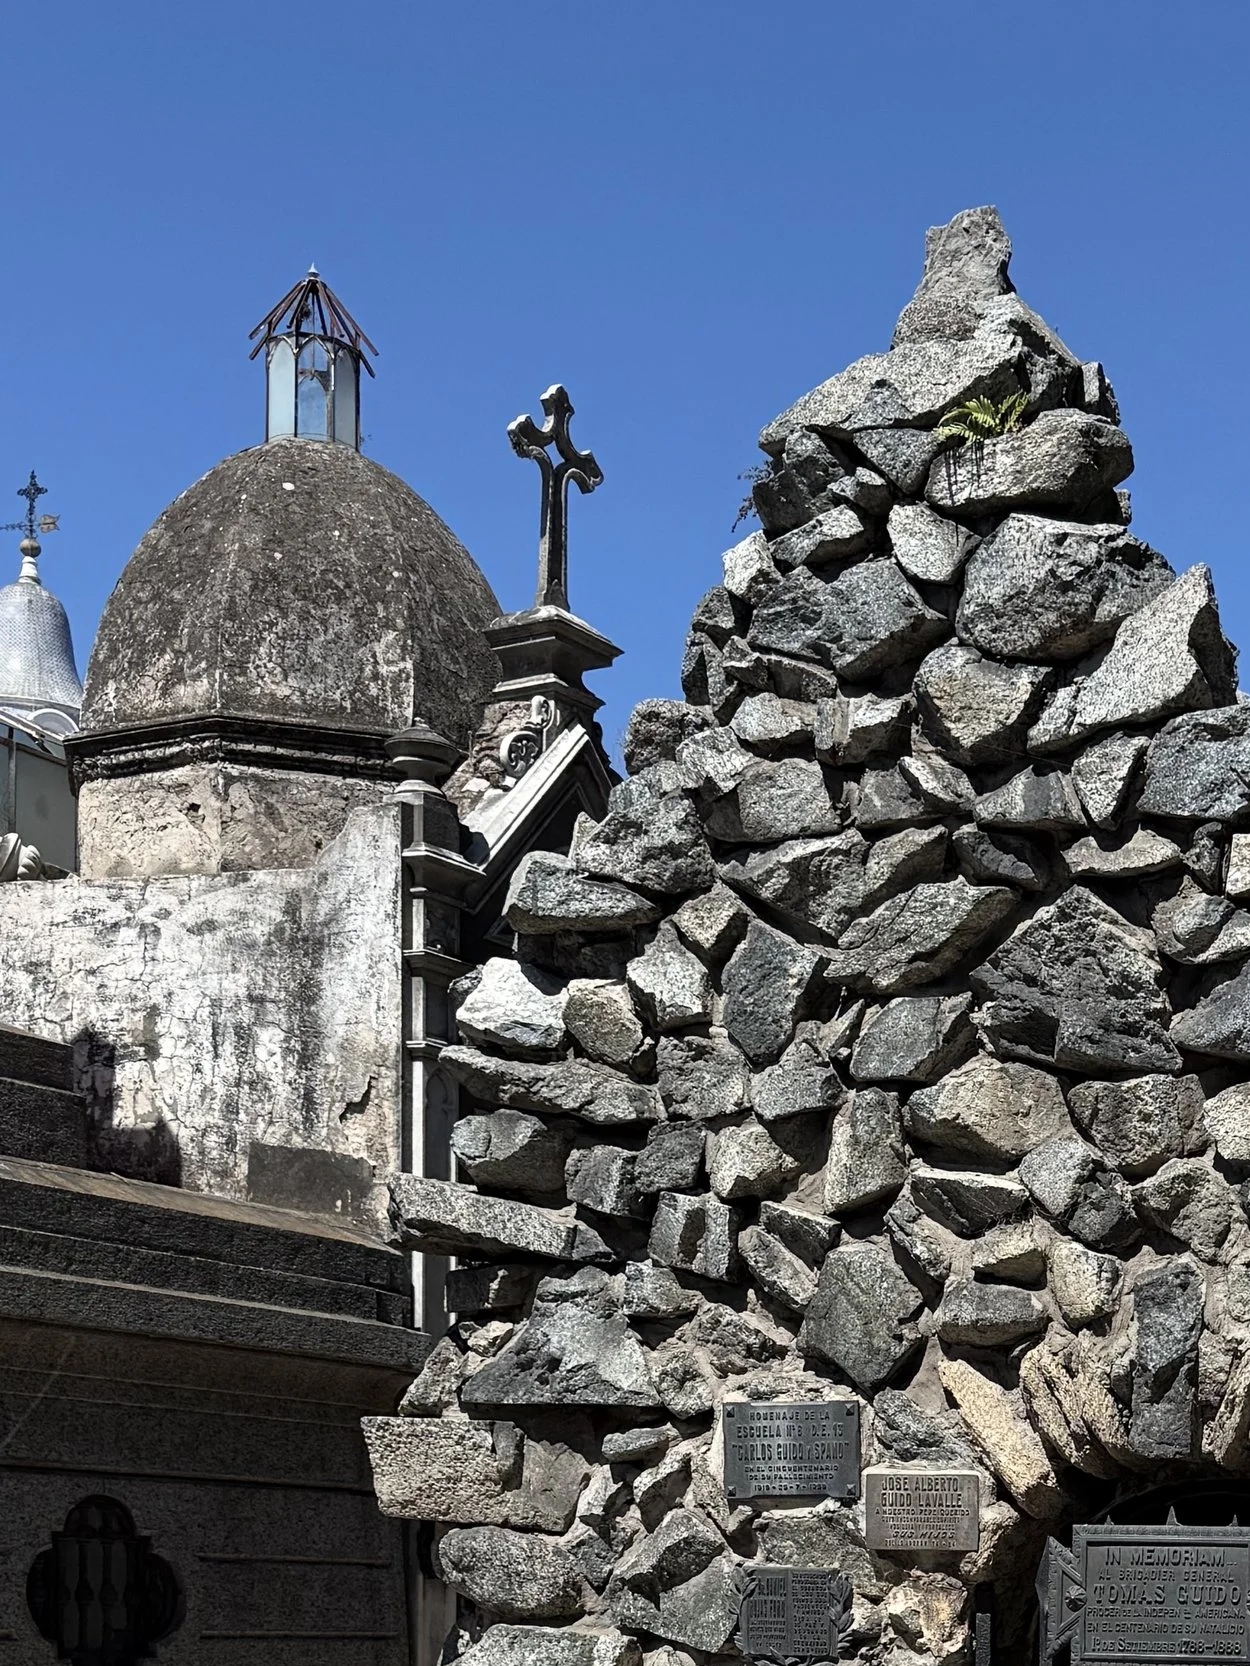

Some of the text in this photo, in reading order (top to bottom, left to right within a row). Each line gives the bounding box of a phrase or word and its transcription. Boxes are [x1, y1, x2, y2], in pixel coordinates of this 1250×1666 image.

[749, 1410, 831, 1421] HOMENAJE DE LA
[736, 1424, 782, 1439] ESCUELA
[810, 1423, 831, 1438] D.E.
[776, 1441, 804, 1461] GUIDO
[744, 1464, 840, 1474] EN EL CINCUENTENARIO
[773, 1472, 835, 1481] FALLECIMIENTO
[881, 1476, 959, 1493] JOSE ALBERTO
[880, 1492, 963, 1509] GUIDO LAVALLE
[940, 1508, 971, 1518] QUERIDO
[919, 1530, 956, 1540] HIJOS
[1104, 1548, 1121, 1566] IN
[1098, 1568, 1235, 1583] AL BRIGADIER GENERAL
[1177, 1584, 1242, 1606] GUIDO
[1194, 1607, 1246, 1620] AMERICANA
[1086, 1621, 1246, 1636] EN EL CENTENARIO DE SU NATALICIO
[1102, 1640, 1115, 1652] DE
